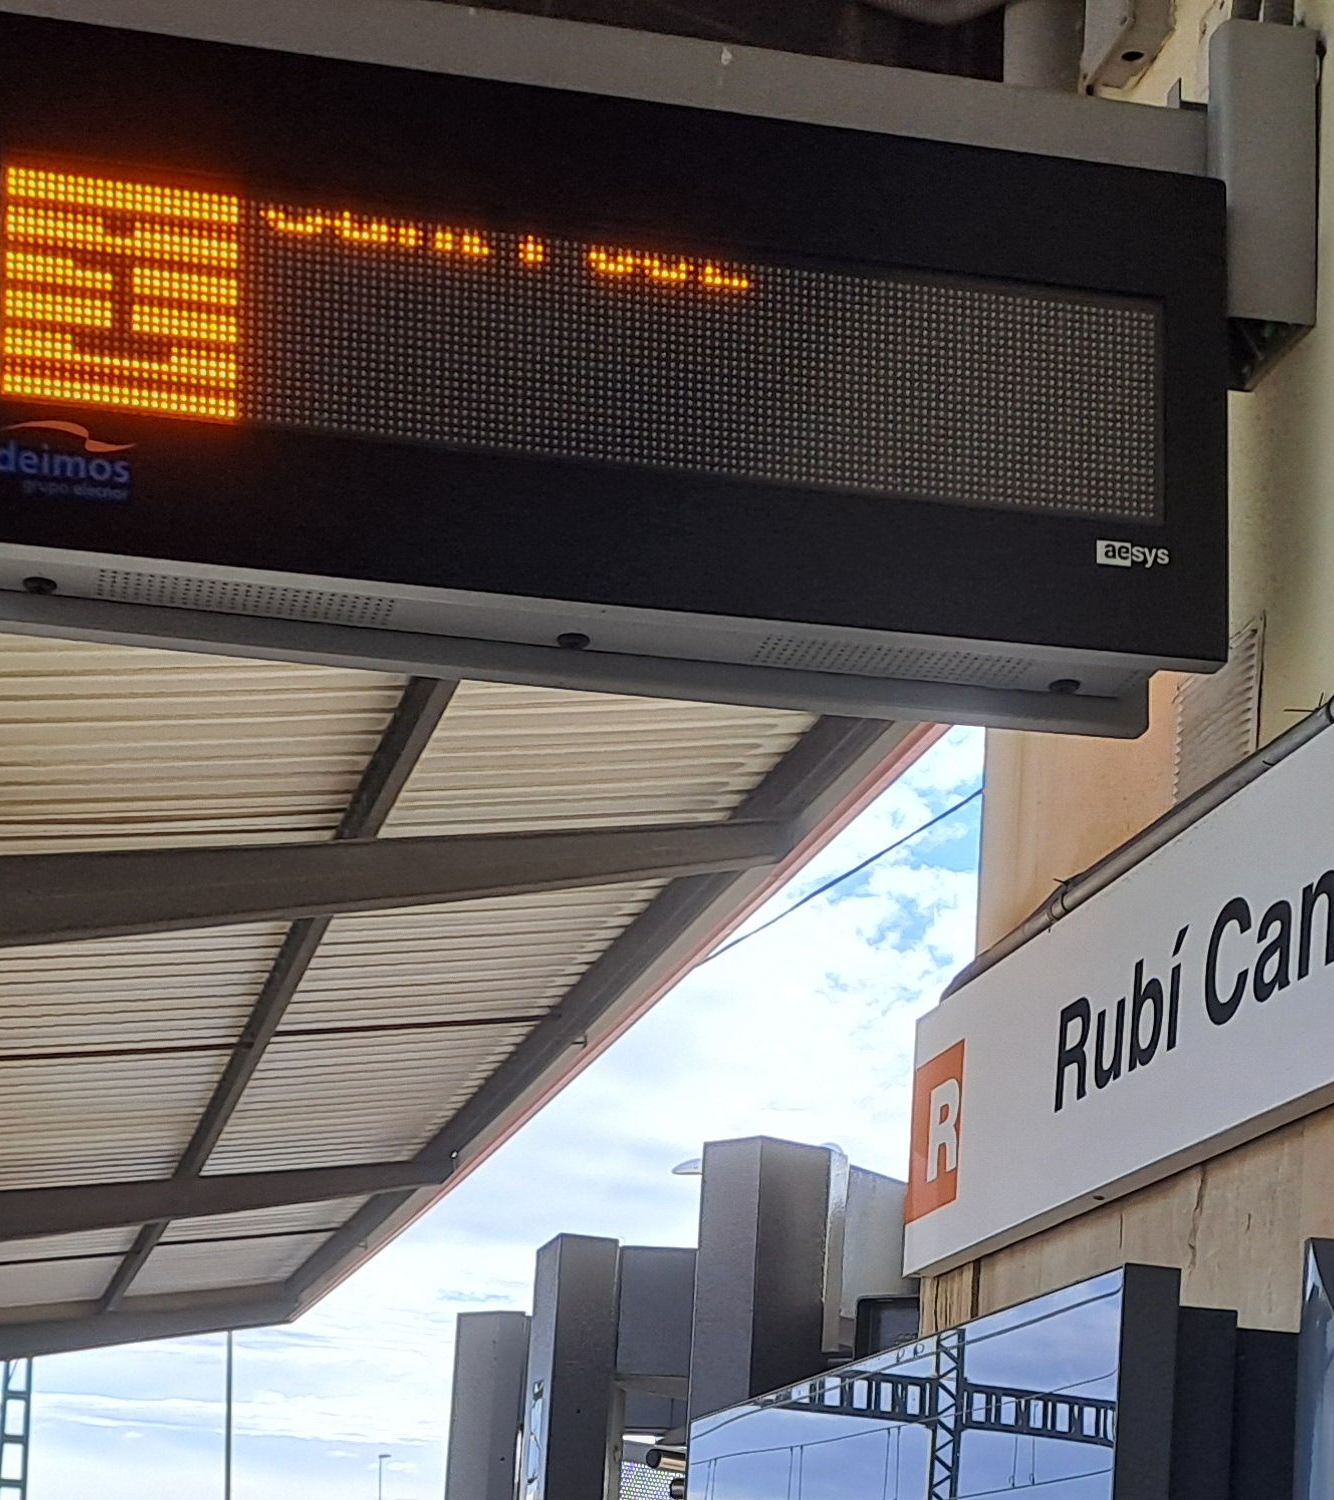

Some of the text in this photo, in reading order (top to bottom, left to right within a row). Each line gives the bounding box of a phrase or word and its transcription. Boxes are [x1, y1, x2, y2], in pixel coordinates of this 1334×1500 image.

[1102, 542, 1170, 569] aesys
[1054, 925, 1190, 1113] Rubí
[926, 1077, 960, 1184] R
